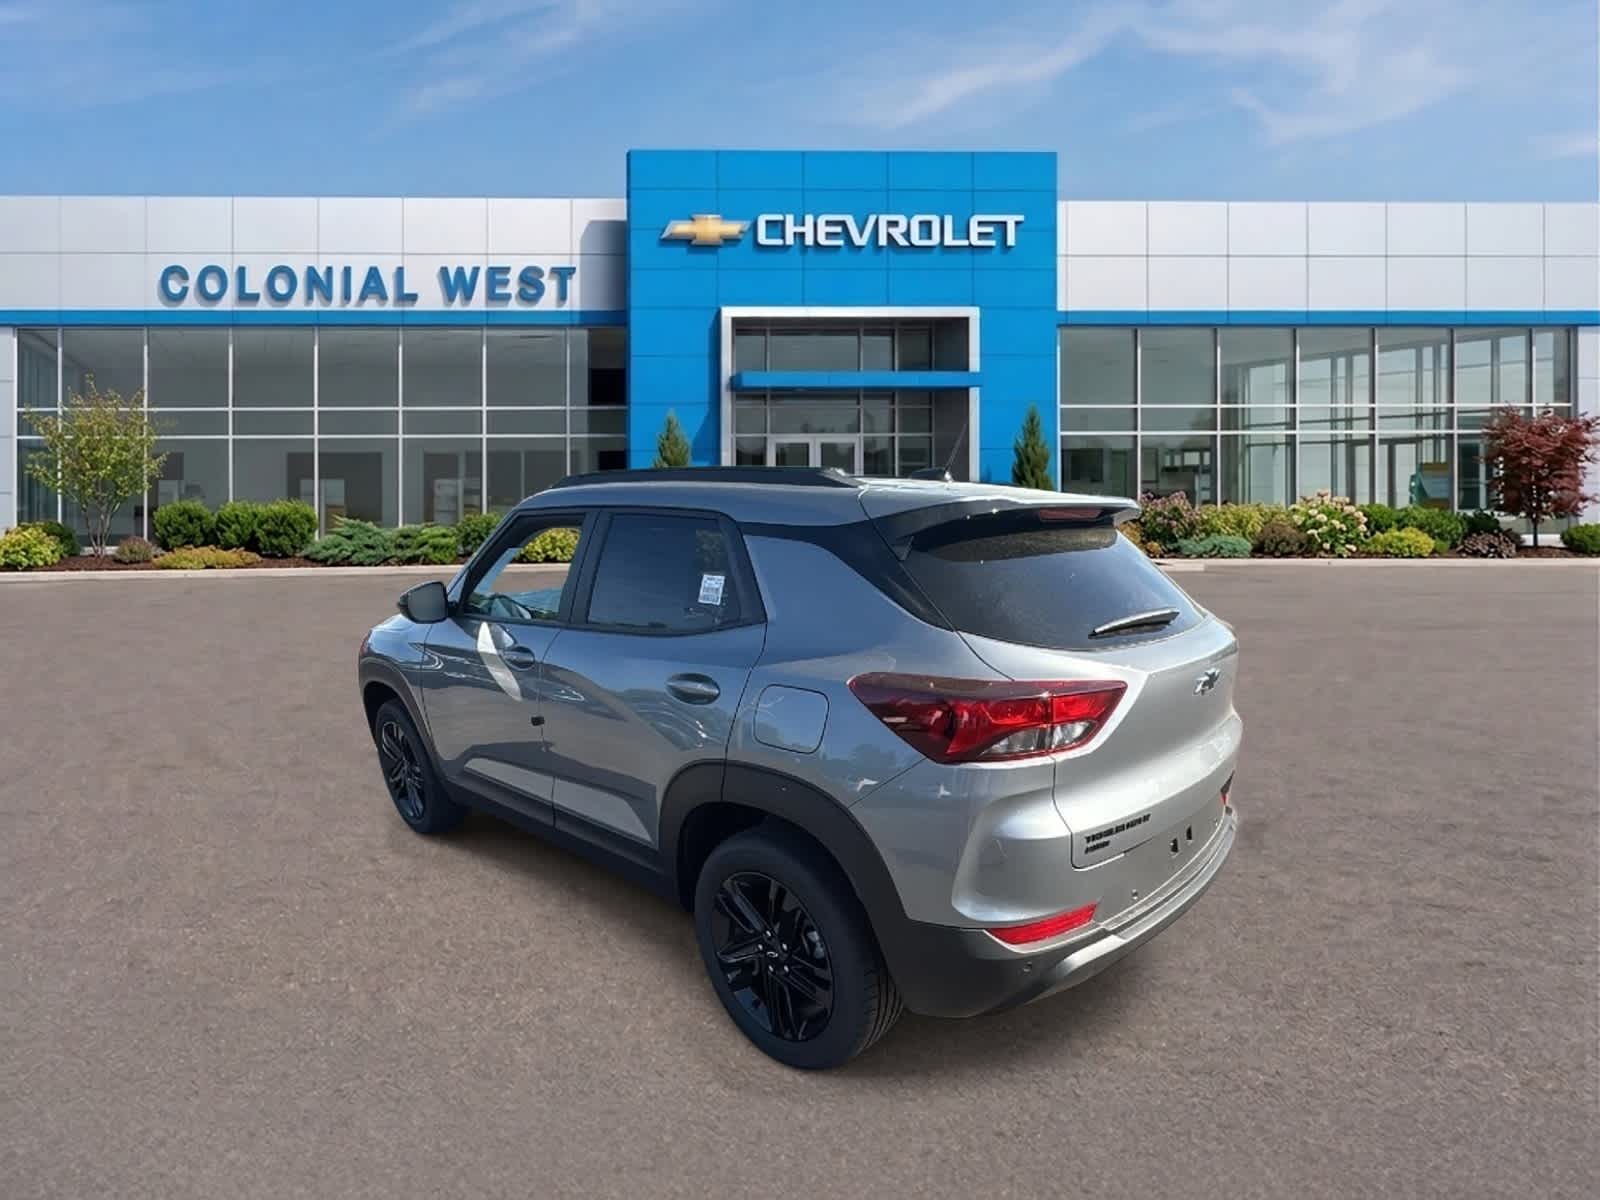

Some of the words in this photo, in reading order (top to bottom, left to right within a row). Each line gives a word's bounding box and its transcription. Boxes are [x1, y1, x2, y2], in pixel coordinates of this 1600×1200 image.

[756, 214, 1024, 247] CHEVROLET
[159, 265, 418, 305] COLONIAL
[440, 265, 577, 305] WEST
